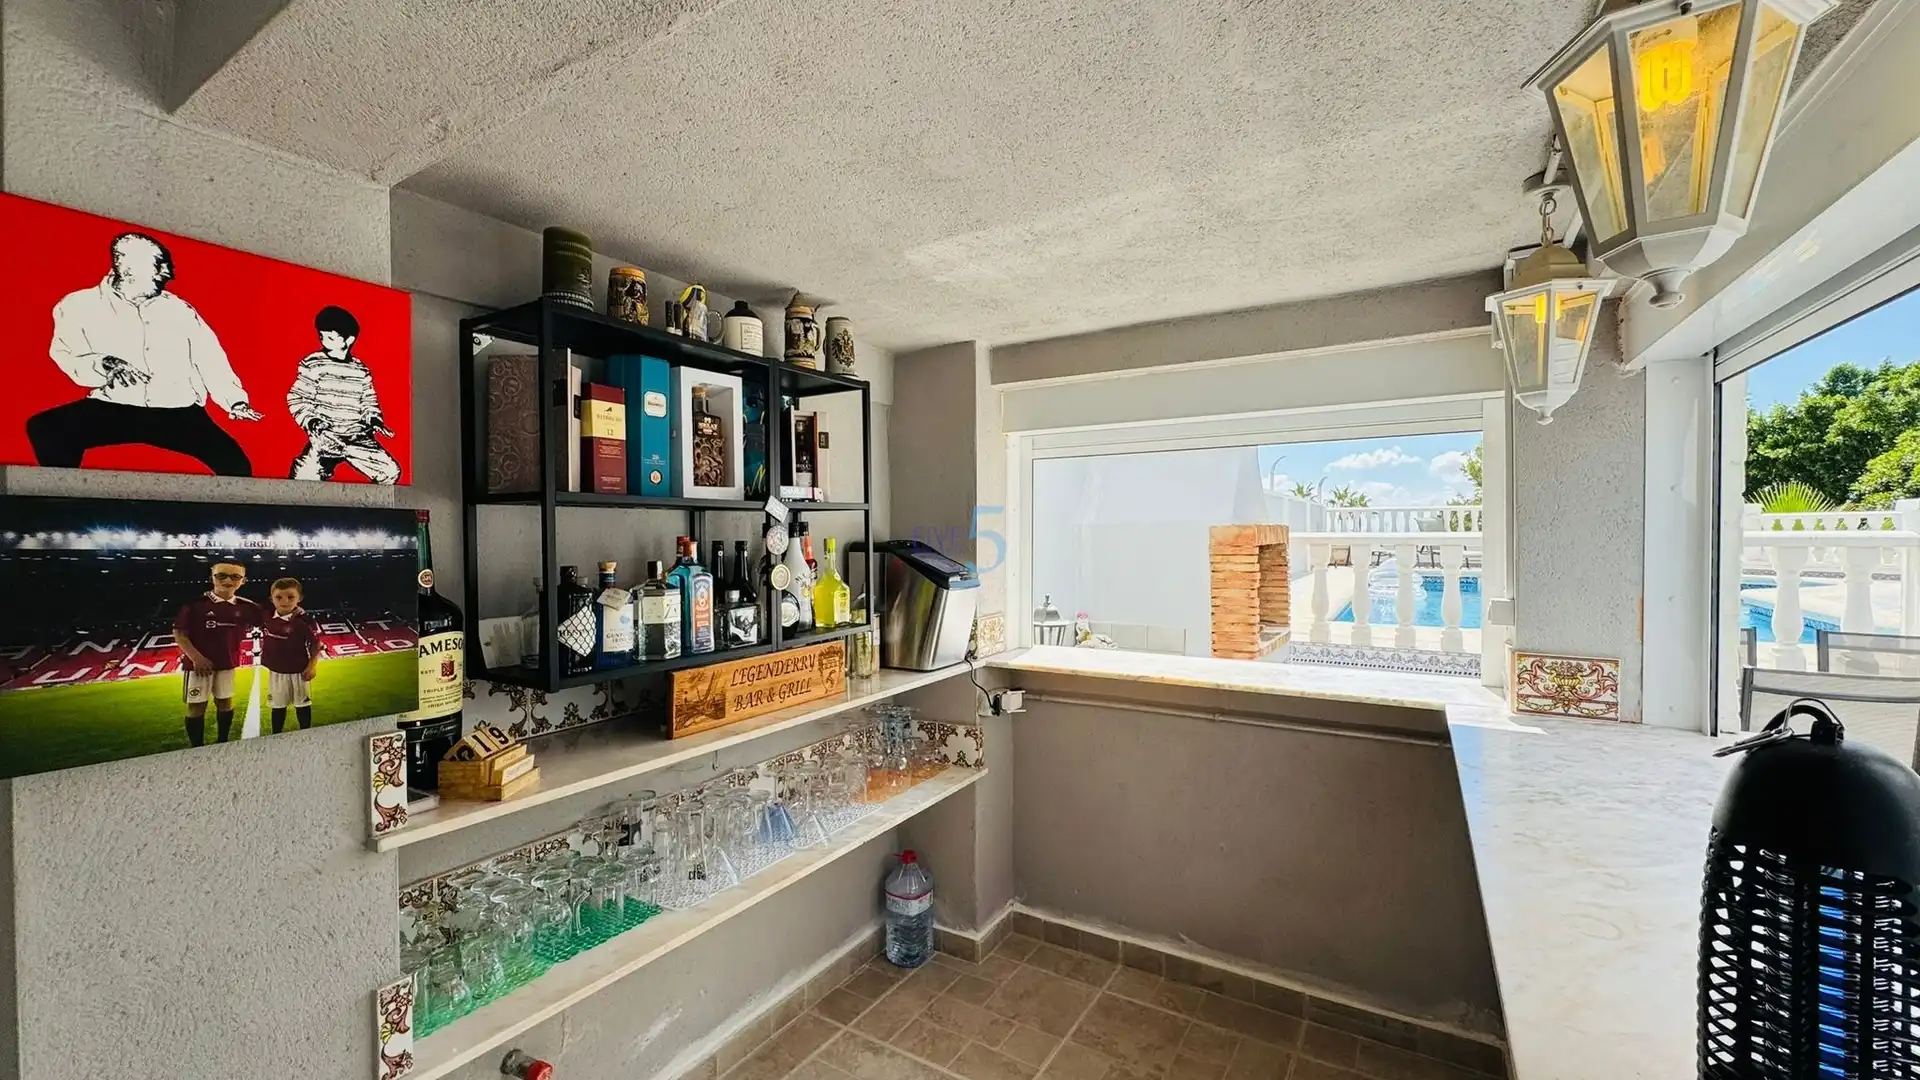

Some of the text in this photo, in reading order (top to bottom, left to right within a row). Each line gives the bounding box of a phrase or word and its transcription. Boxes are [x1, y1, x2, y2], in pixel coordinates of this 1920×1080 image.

[180, 539, 201, 548] SIR
[418, 637, 465, 659] AMESO
[730, 653, 816, 688] LEGENDERRY
[734, 677, 812, 712] BAR & GRILL
